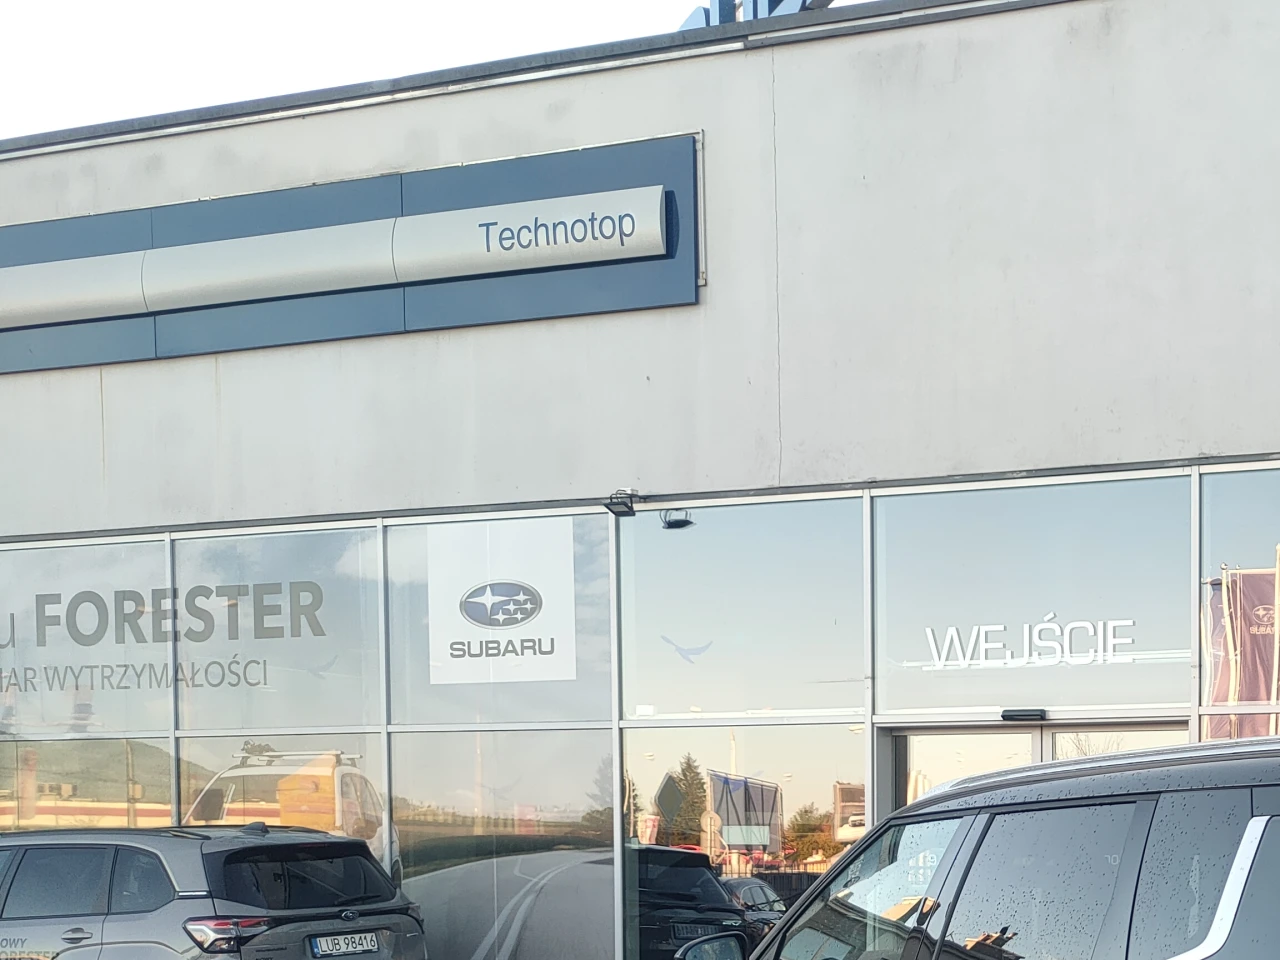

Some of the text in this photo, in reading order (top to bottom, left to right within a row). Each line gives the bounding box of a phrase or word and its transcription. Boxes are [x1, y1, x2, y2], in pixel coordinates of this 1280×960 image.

[478, 211, 636, 253] Technotop
[35, 580, 327, 647] FORESTER
[450, 637, 555, 659] SUBARU
[923, 611, 1135, 670] WEJŚCIE
[43, 653, 268, 692] WYTRZYMAŁOŚCI
[319, 934, 376, 953] LUB 98416
